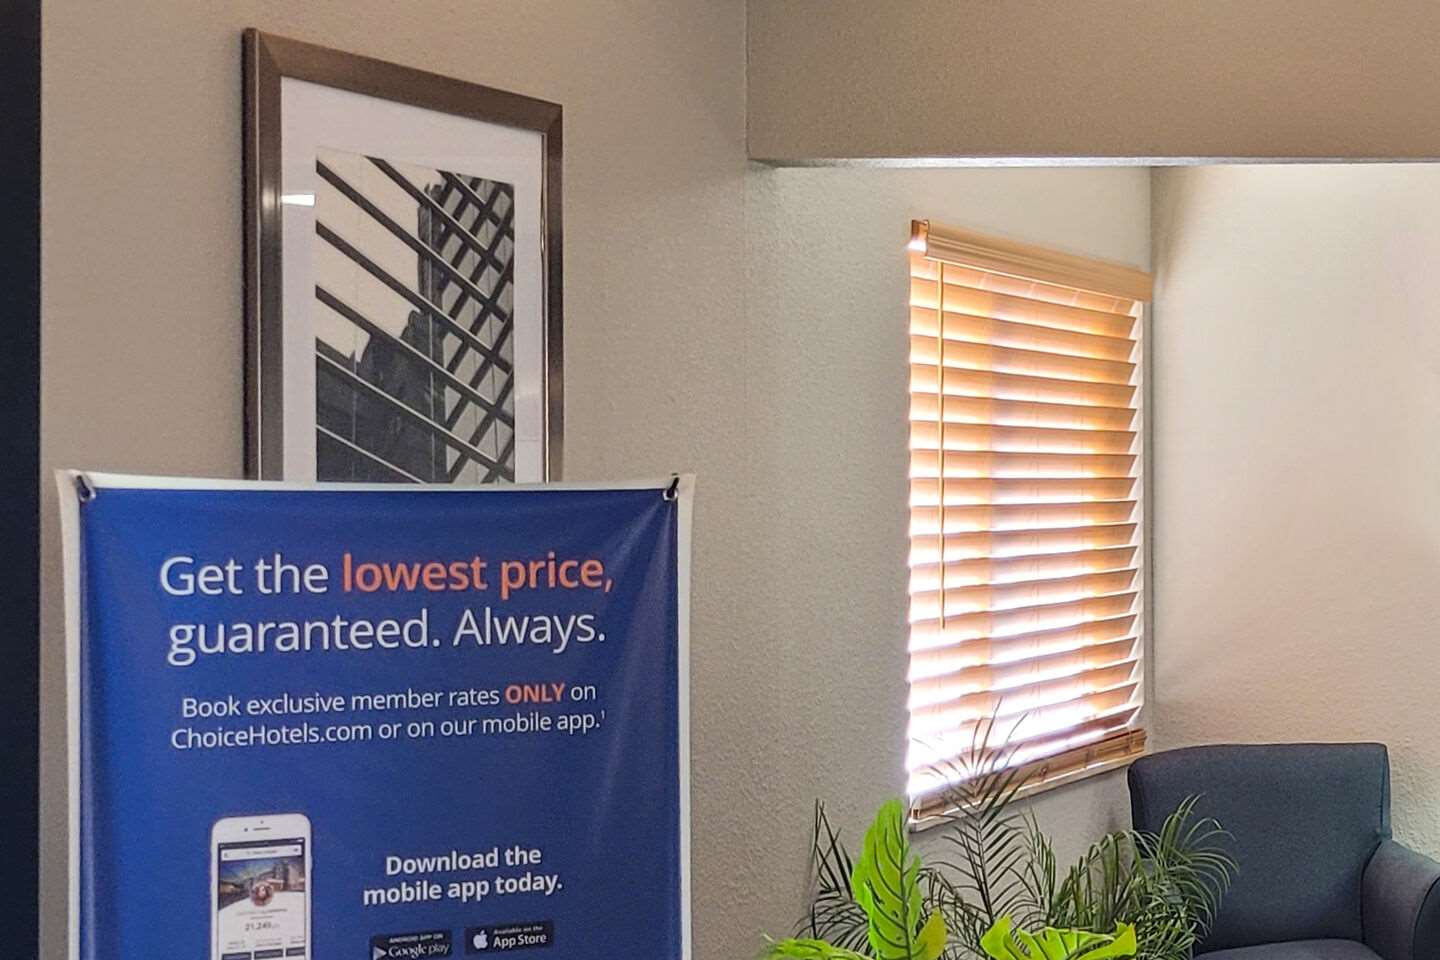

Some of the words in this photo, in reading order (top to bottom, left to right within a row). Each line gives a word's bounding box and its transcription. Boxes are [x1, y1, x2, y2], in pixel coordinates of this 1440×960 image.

[160, 556, 243, 596] Get
[255, 553, 329, 593] the
[343, 552, 488, 592] lowest
[501, 551, 613, 600] price,
[167, 607, 440, 666] guaranteed.
[453, 606, 605, 654] Always.
[182, 696, 240, 717] Book
[247, 693, 345, 715] exclusive
[351, 687, 443, 711] member
[449, 687, 499, 706] rates
[505, 683, 565, 704] ONLY
[571, 685, 596, 701] on
[171, 722, 372, 749] ChoiceHotels.com
[378, 723, 402, 739] or
[407, 722, 434, 737] on
[441, 720, 476, 735] our
[483, 712, 551, 734] mobile
[386, 847, 498, 875] Download
[505, 845, 541, 866] the
[363, 881, 442, 905] mobile
[448, 880, 489, 902] app
[495, 872, 563, 895] today.
[389, 944, 427, 959] Google
[428, 944, 449, 955] play
[493, 936, 516, 949] App
[518, 934, 547, 945] Store
